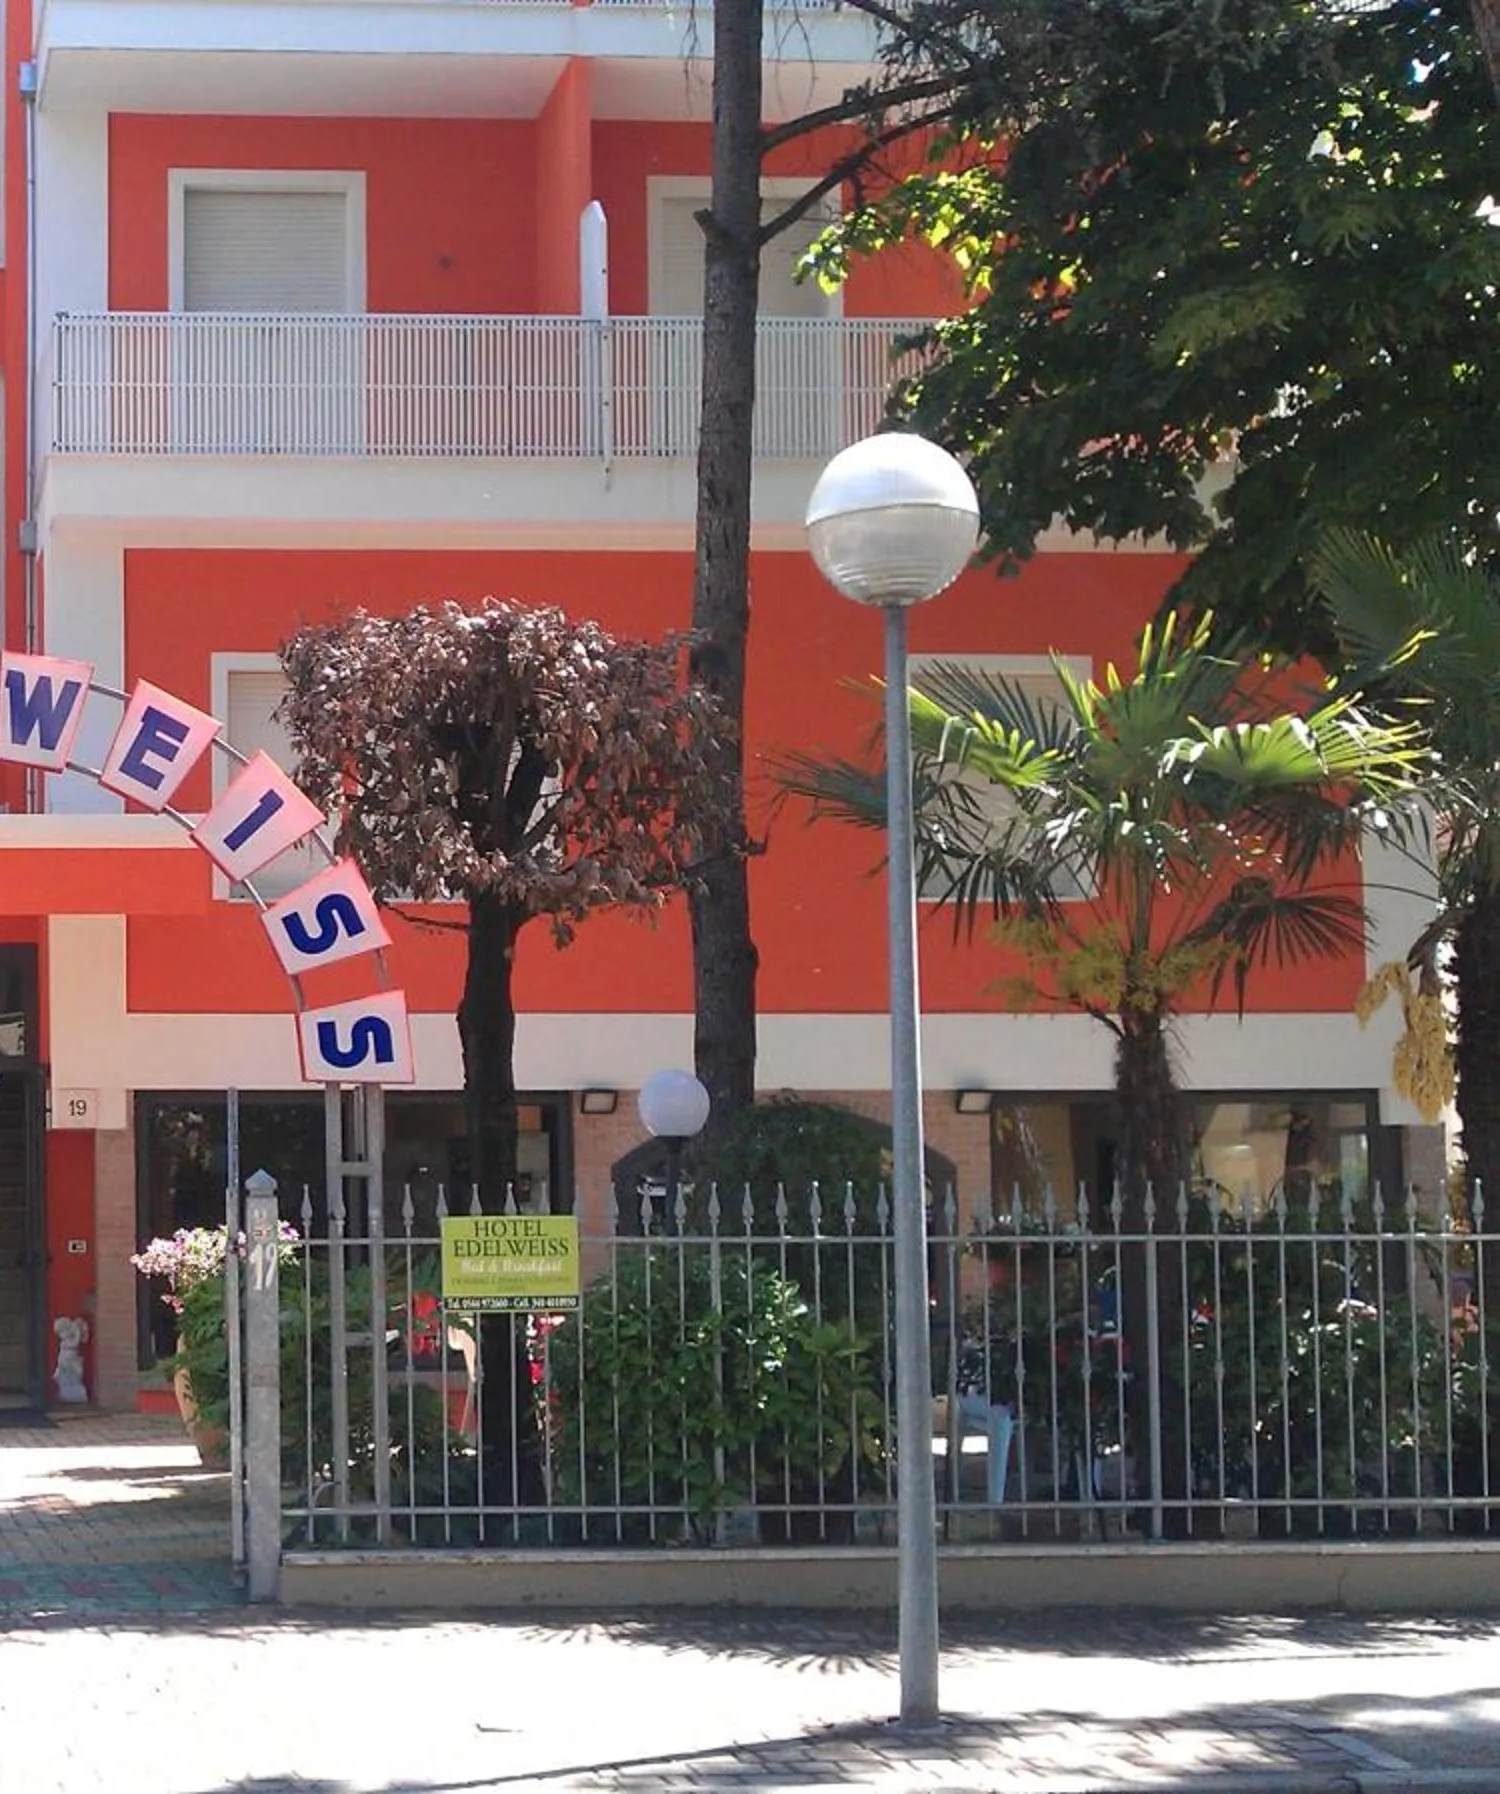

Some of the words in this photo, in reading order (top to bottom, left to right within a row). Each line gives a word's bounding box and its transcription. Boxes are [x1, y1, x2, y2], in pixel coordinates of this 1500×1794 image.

[68, 1099, 87, 1117] 19
[474, 1219, 548, 1237] HOTEL
[453, 1239, 569, 1257] EDELWEISS
[461, 1259, 484, 1274] Bed
[502, 1258, 562, 1277] Breakfast
